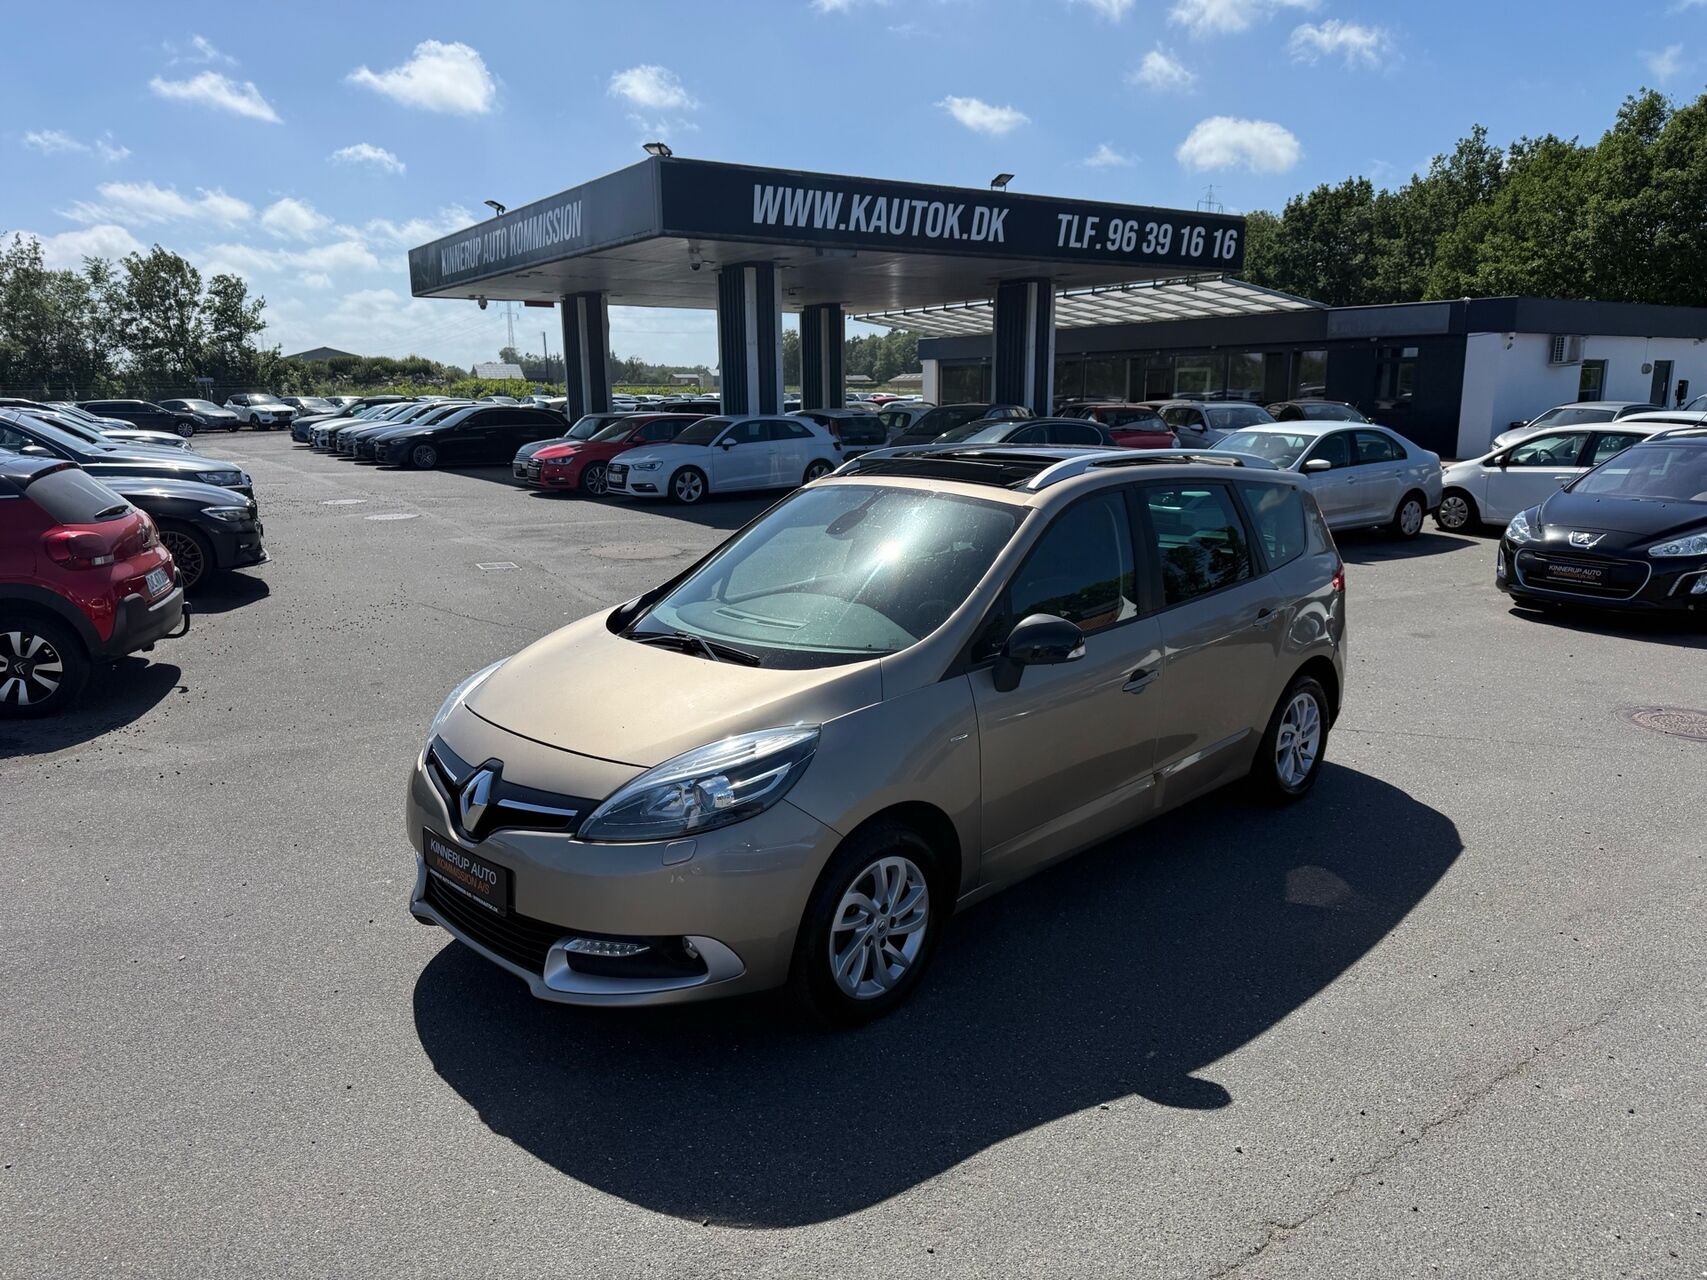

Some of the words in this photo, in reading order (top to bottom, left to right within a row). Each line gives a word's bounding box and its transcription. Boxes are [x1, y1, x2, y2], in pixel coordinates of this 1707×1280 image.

[753, 184, 1009, 243] WWW.KAUTOK.DK
[1057, 213, 1102, 250] TLF.
[1106, 218, 1139, 252] 96
[1142, 222, 1173, 255] 39
[1180, 225, 1206, 257] 16
[1212, 228, 1238, 260] 16
[441, 237, 481, 277] KINNERUP
[483, 227, 507, 264] AUTO
[510, 200, 582, 257] KOMMISSION
[1549, 565, 1582, 573] KINNERUP
[430, 838, 470, 869] KINNERUP
[470, 863, 497, 885] AUTO
